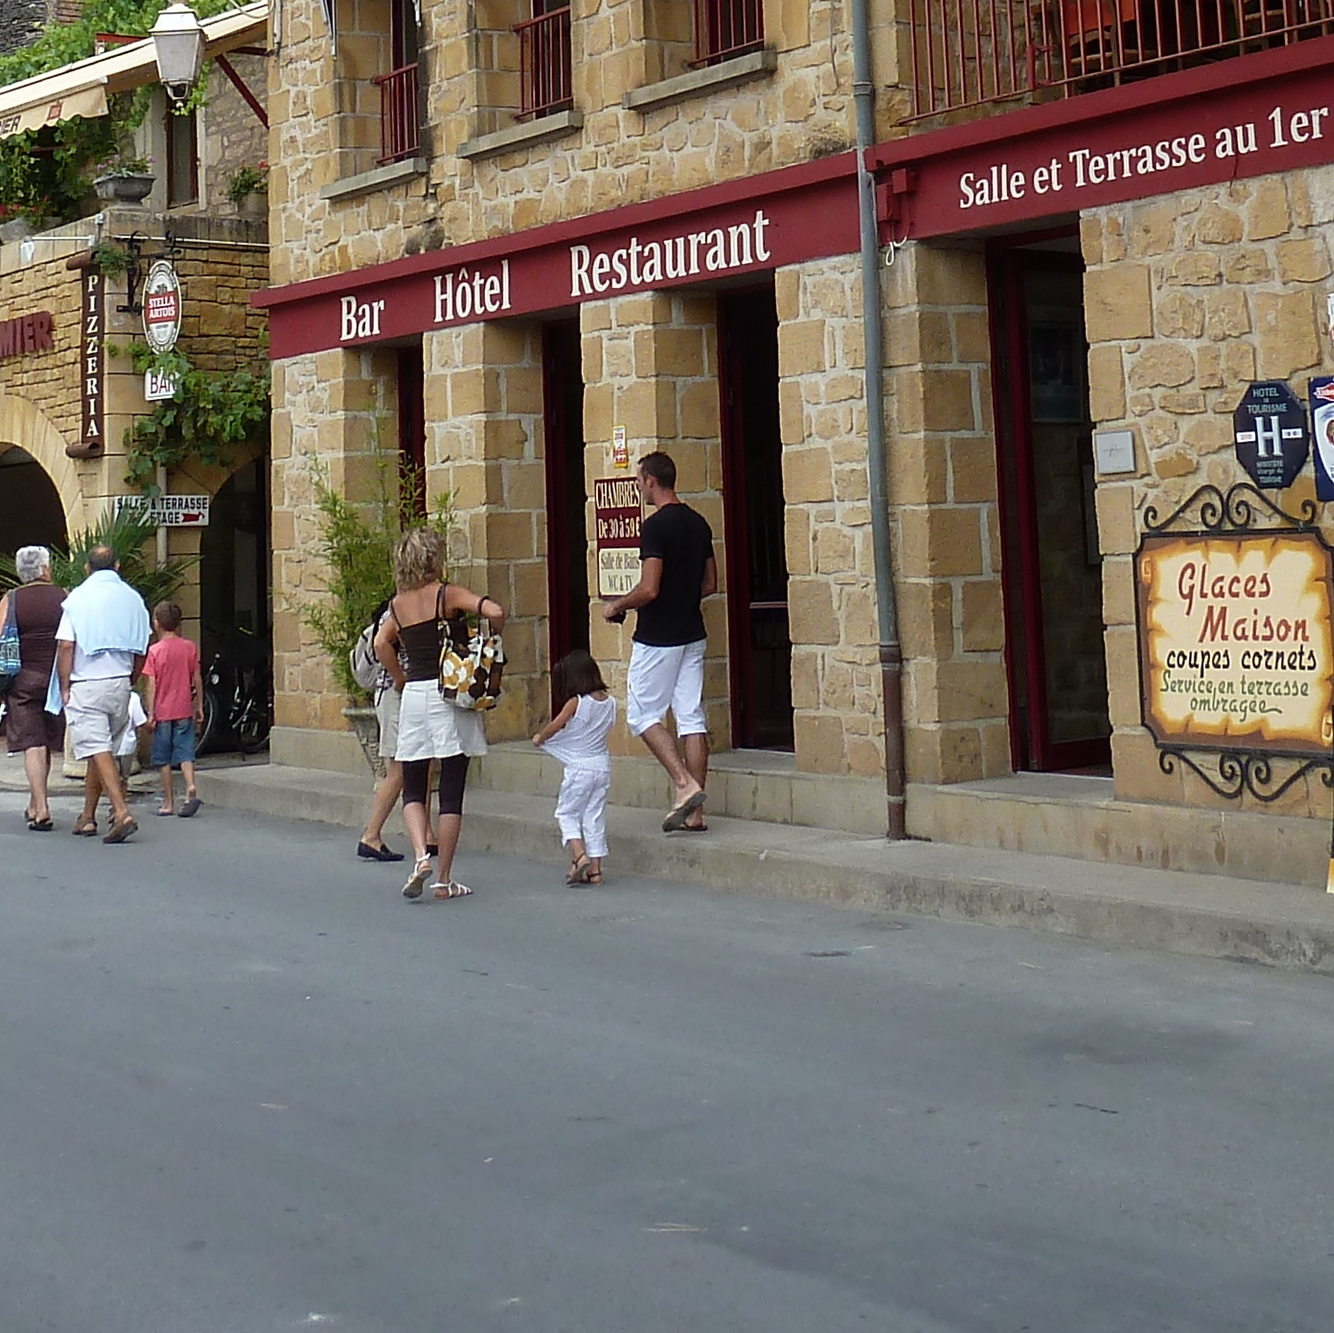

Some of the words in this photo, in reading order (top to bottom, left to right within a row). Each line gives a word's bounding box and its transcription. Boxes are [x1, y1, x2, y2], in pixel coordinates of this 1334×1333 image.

[959, 164, 1026, 209] Salle
[1033, 159, 1062, 195] et
[1069, 131, 1206, 187] Terrasse
[1215, 122, 1258, 160] au
[1268, 106, 1329, 149] 1er
[340, 295, 384, 341] Bar
[433, 259, 512, 323] Hôtel
[570, 210, 771, 297] Restaurant
[149, 295, 175, 309] STELLA
[85, 274, 100, 438] PIZZERIA
[1252, 387, 1280, 398] HOTEL
[1247, 403, 1288, 414] TOURISME
[1255, 415, 1283, 457] H
[160, 497, 208, 510] TERRASSE
[595, 481, 641, 510] CHAMBRES
[598, 518, 608, 539] De
[619, 514, 625, 538] à
[600, 553, 615, 570] Salle
[616, 553, 623, 570] de
[624, 553, 641, 570] Bains
[1178, 562, 1271, 616] Glaces
[1198, 605, 1310, 643] Maison
[1166, 647, 1231, 678] coupes
[1241, 644, 1317, 672] cornets
[1160, 669, 1214, 694] Service
[1218, 679, 1235, 696] en
[1240, 675, 1309, 697] terrasse
[1190, 687, 1283, 723] ombragée
